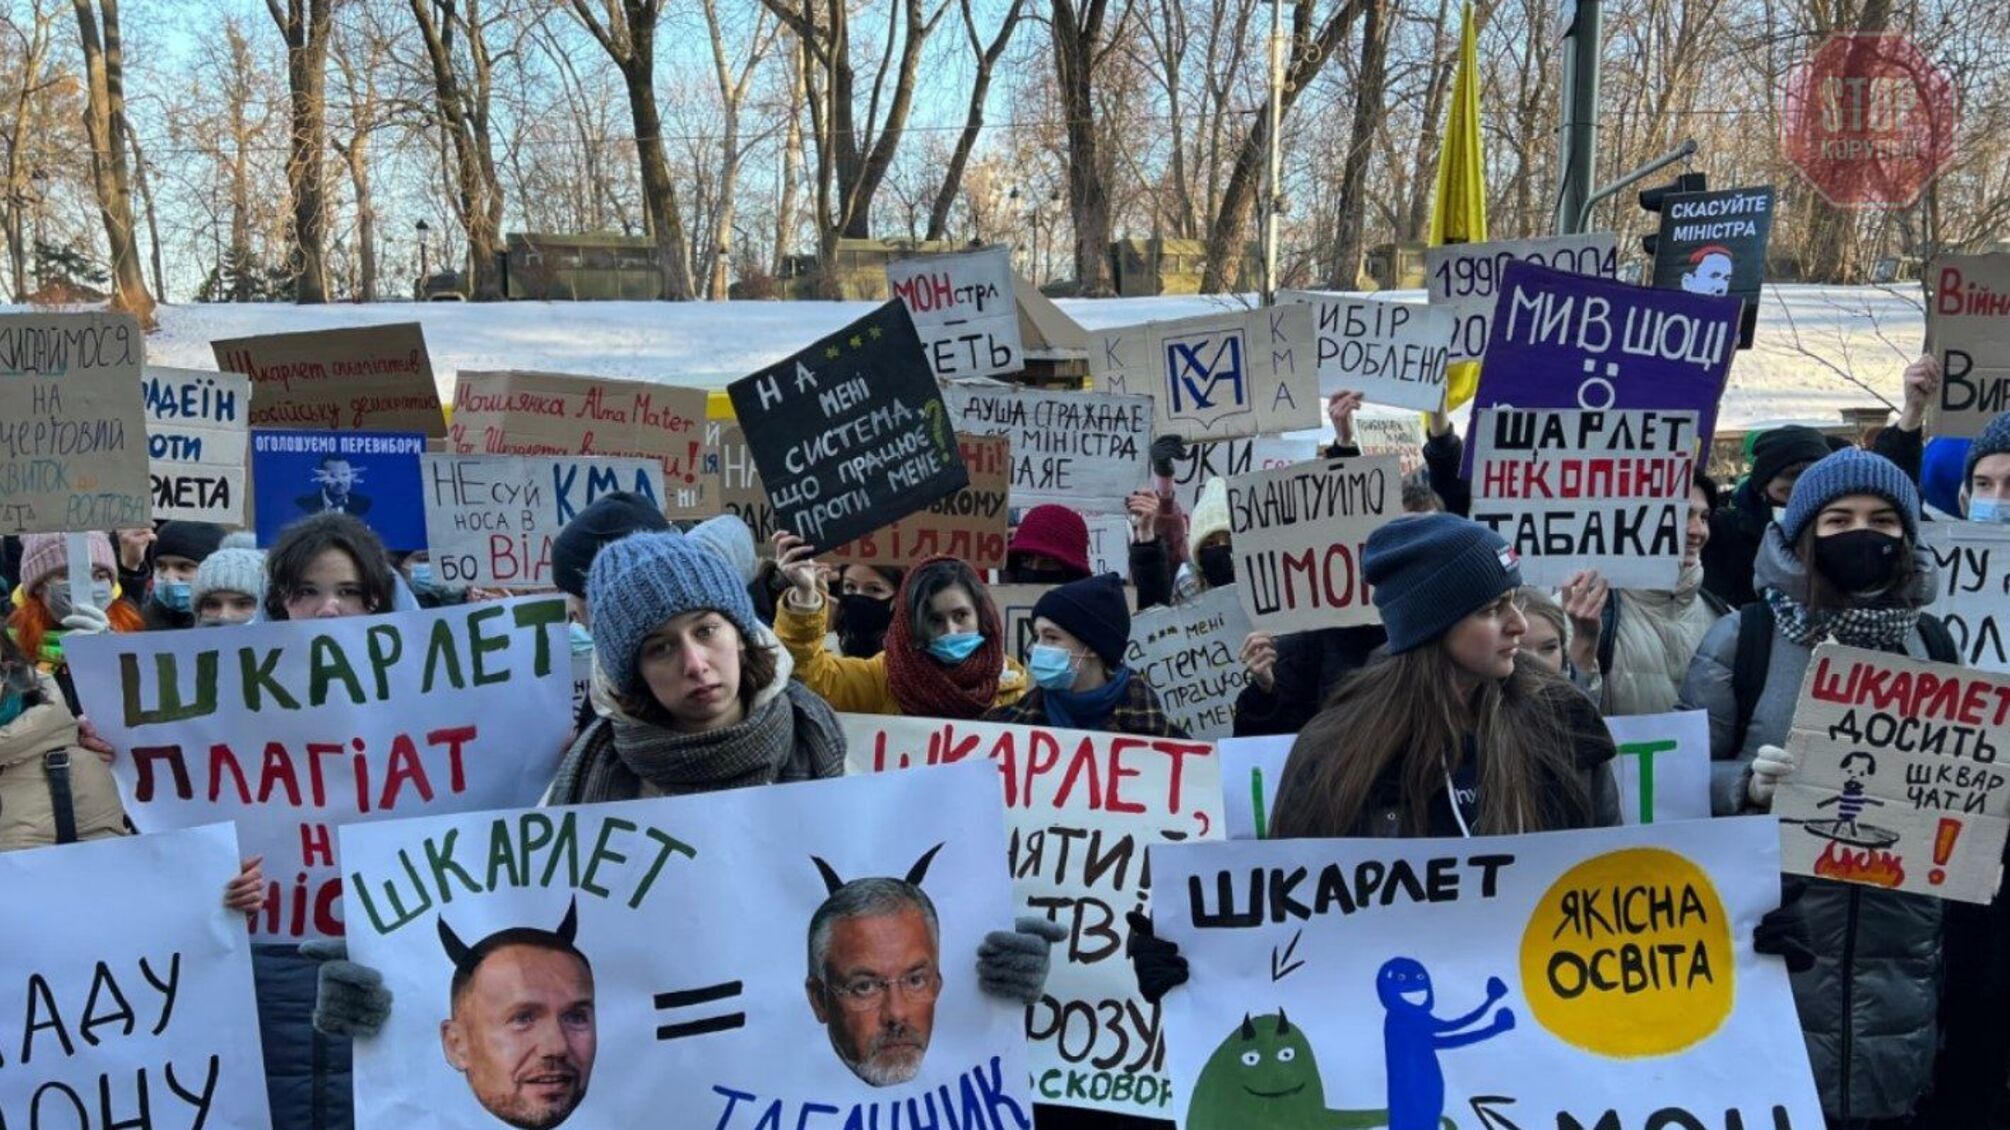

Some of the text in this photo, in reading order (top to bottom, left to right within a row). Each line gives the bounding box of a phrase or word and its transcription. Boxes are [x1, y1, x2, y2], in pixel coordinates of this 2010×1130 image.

[1671, 195, 1767, 219] СКАСУЙТЕ
[1673, 219, 1757, 242] МІНІСТРА
[1318, 302, 1410, 339] ИБІР
[1506, 284, 1728, 371] МИ В ШОЦІ
[922, 334, 1012, 373] ЕТЬ
[33, 384, 62, 415] НА
[575, 386, 625, 423] Alma
[632, 393, 695, 433] Mater
[819, 371, 871, 418] МЕНІ
[964, 397, 1027, 426] ДУША
[255, 436, 422, 453] ОГОЛОШУЄМО ПЕРЕВИБОРИ
[771, 423, 930, 509] ЩО ПРАЦЮЄ
[1021, 428, 1139, 461] МІНІСТРА
[433, 460, 486, 507] НЕ
[1229, 462, 1387, 533] ВЛАШТУЙМО
[454, 509, 536, 531] НОСА В
[794, 488, 872, 541] ПРОТИ
[833, 523, 1005, 562] ВІЛЛЮ
[440, 555, 478, 581] БО
[117, 599, 567, 729] ШКАРЛЕТ
[1828, 708, 1997, 764] ДОСИТЬ
[131, 725, 478, 813] ПЛАГІАТ
[1906, 762, 2005, 792] ШКВАР
[1907, 785, 1988, 814] ЧАТИ
[351, 812, 697, 936] ШКАРЛЕТ
[1188, 854, 1515, 929] ШКАРЛЕТ
[1552, 884, 1708, 942] ЯКІСНА
[1547, 941, 1714, 999] ОСВІТА
